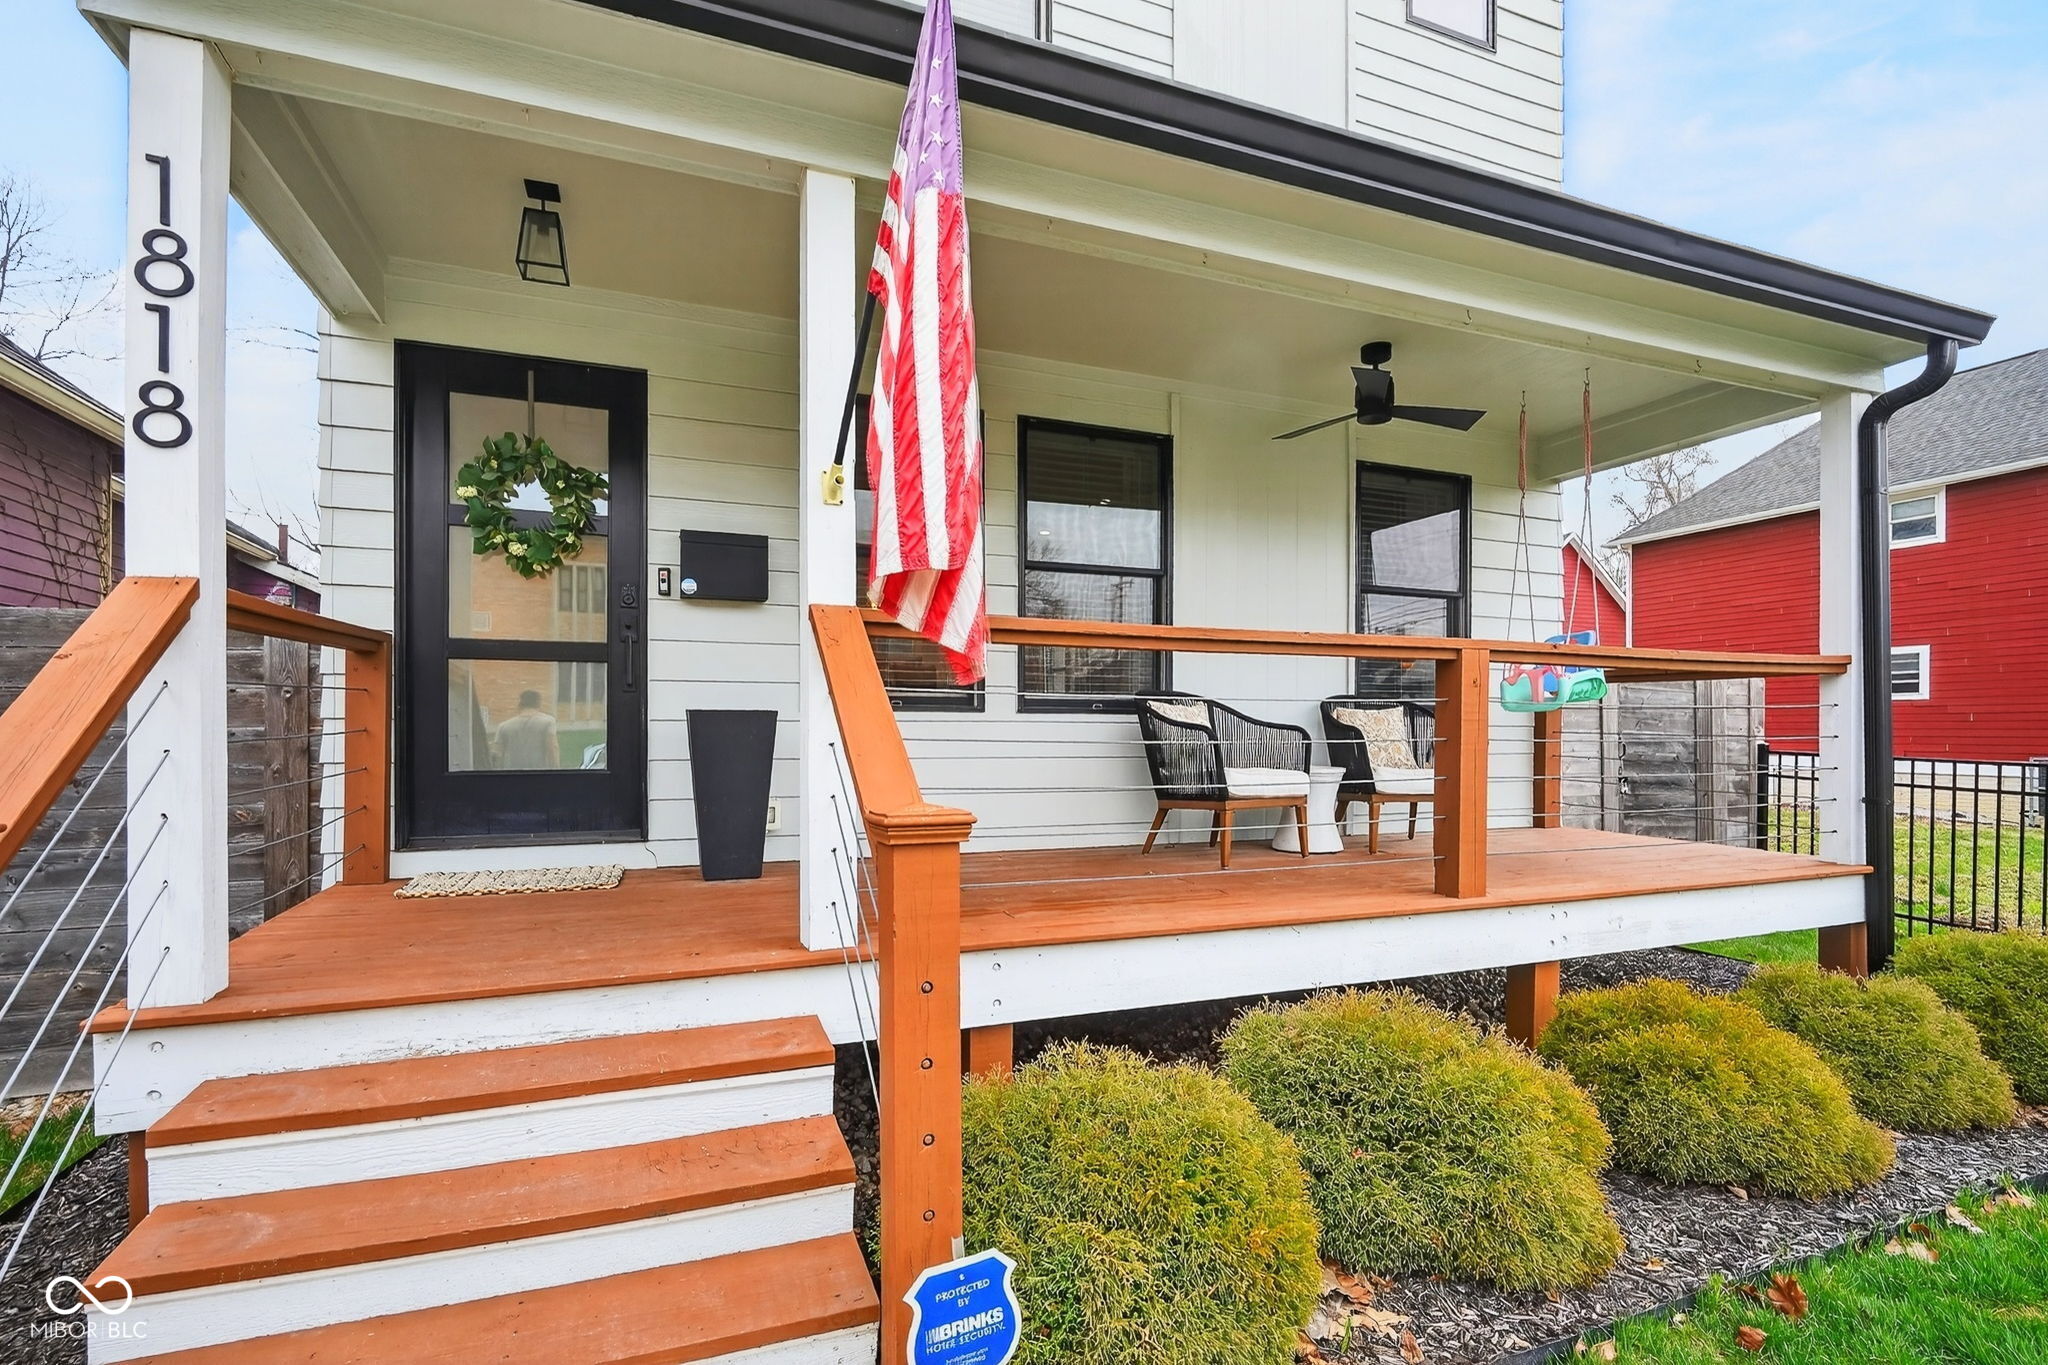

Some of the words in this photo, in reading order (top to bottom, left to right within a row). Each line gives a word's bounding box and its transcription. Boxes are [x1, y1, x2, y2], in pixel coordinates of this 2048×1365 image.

[133, 153, 195, 449] 1818
[939, 1306, 1004, 1340] BRINKS
[926, 1339, 957, 1356] HO
